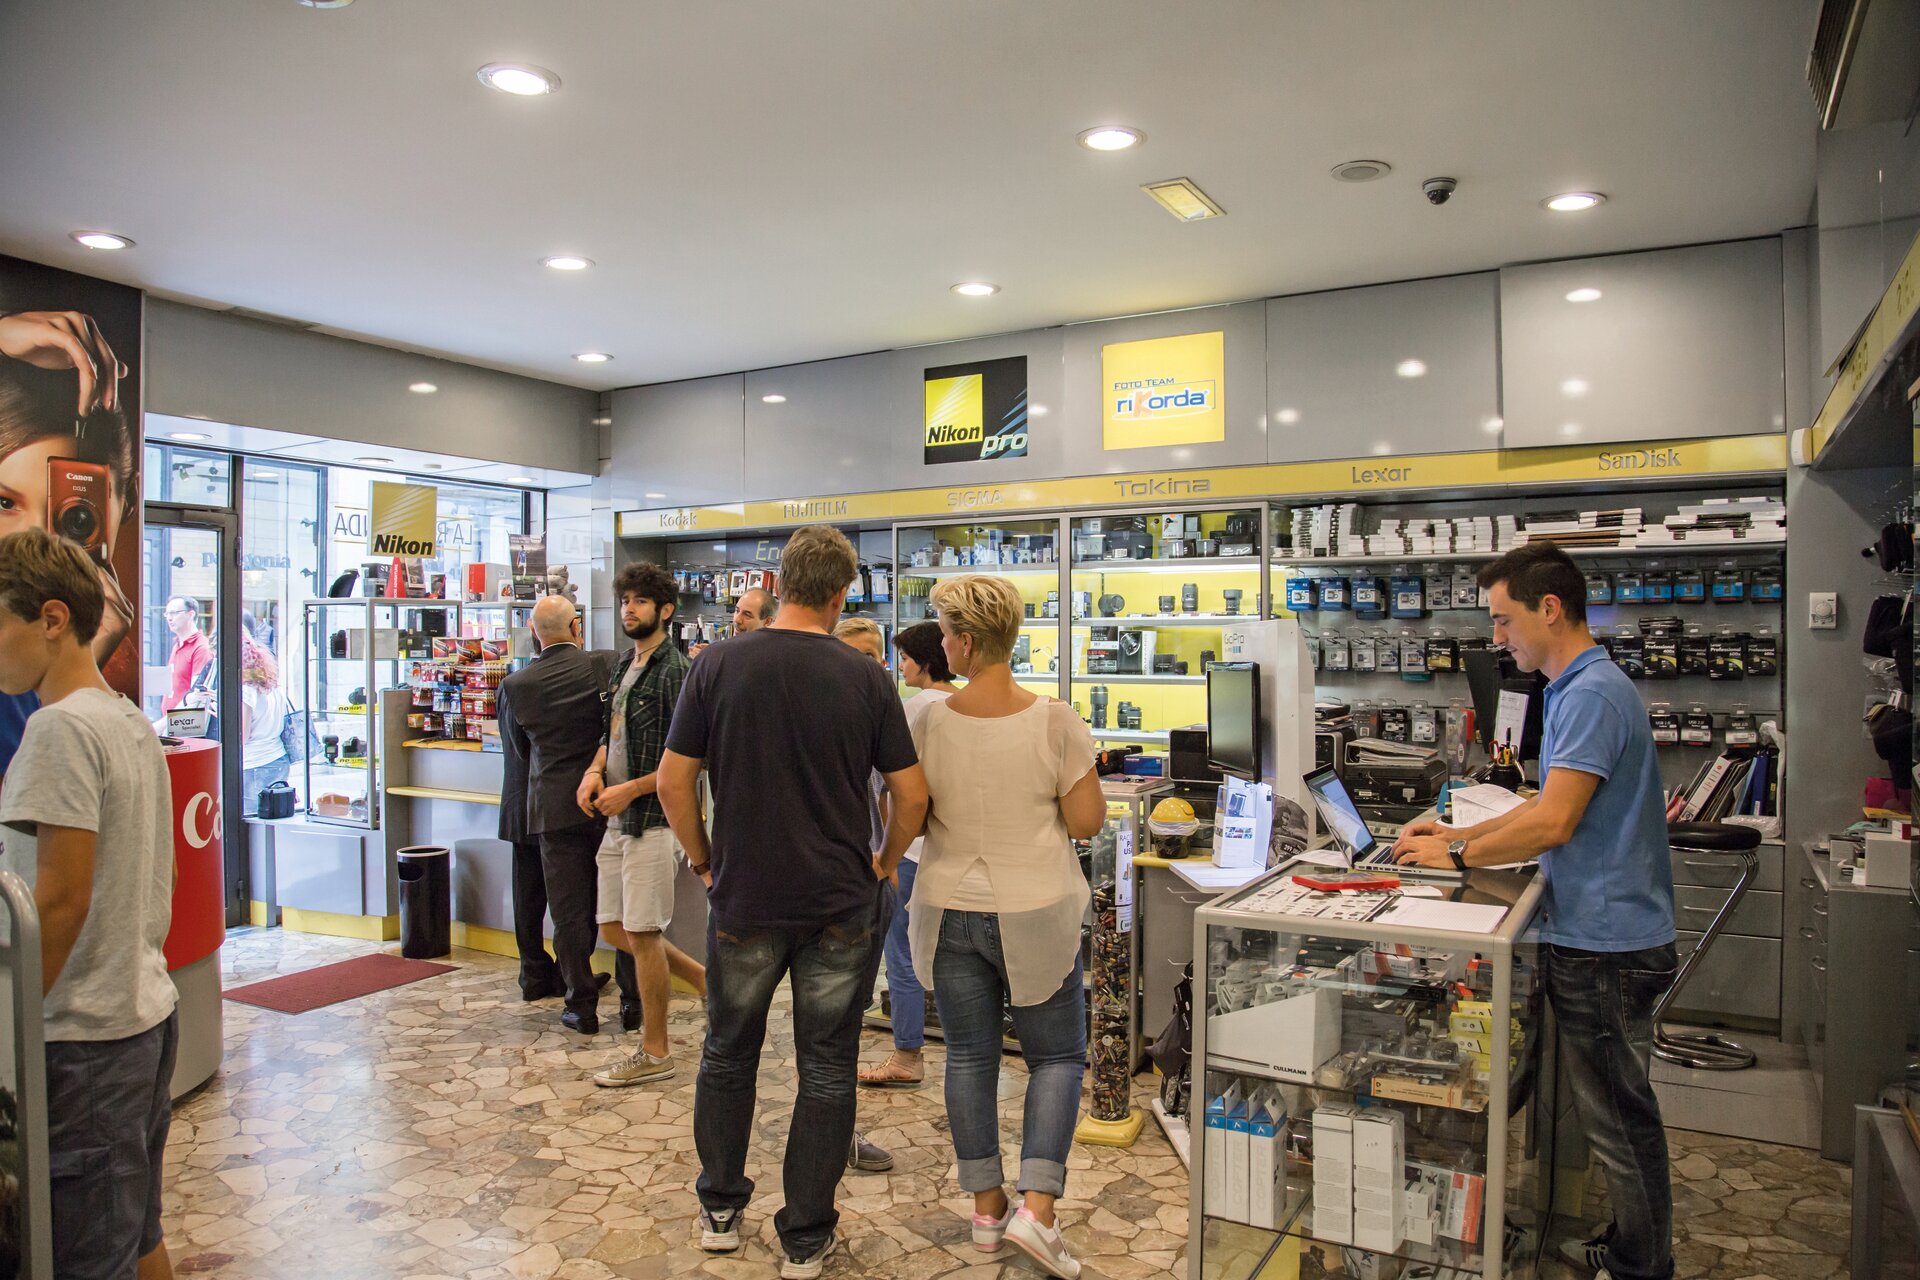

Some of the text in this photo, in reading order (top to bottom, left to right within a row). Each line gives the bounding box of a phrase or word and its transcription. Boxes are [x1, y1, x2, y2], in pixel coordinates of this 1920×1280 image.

[1114, 378, 1175, 390] FOTO TEAM
[928, 423, 981, 445] Nikon
[980, 433, 1028, 458] pro
[1598, 448, 1682, 471] SanDisk
[66, 472, 93, 481] Canon
[1352, 466, 1412, 484] Lexar
[1114, 478, 1211, 498] Tokina
[947, 490, 1003, 507] SIGMA
[784, 501, 848, 518] FUJIFILM
[660, 512, 697, 527] Kodak
[374, 534, 433, 555] Nikon
[1224, 633, 1245, 645] GoPro
[170, 718, 195, 726] Lexar
[1273, 1066, 1307, 1075] CULLMANN
